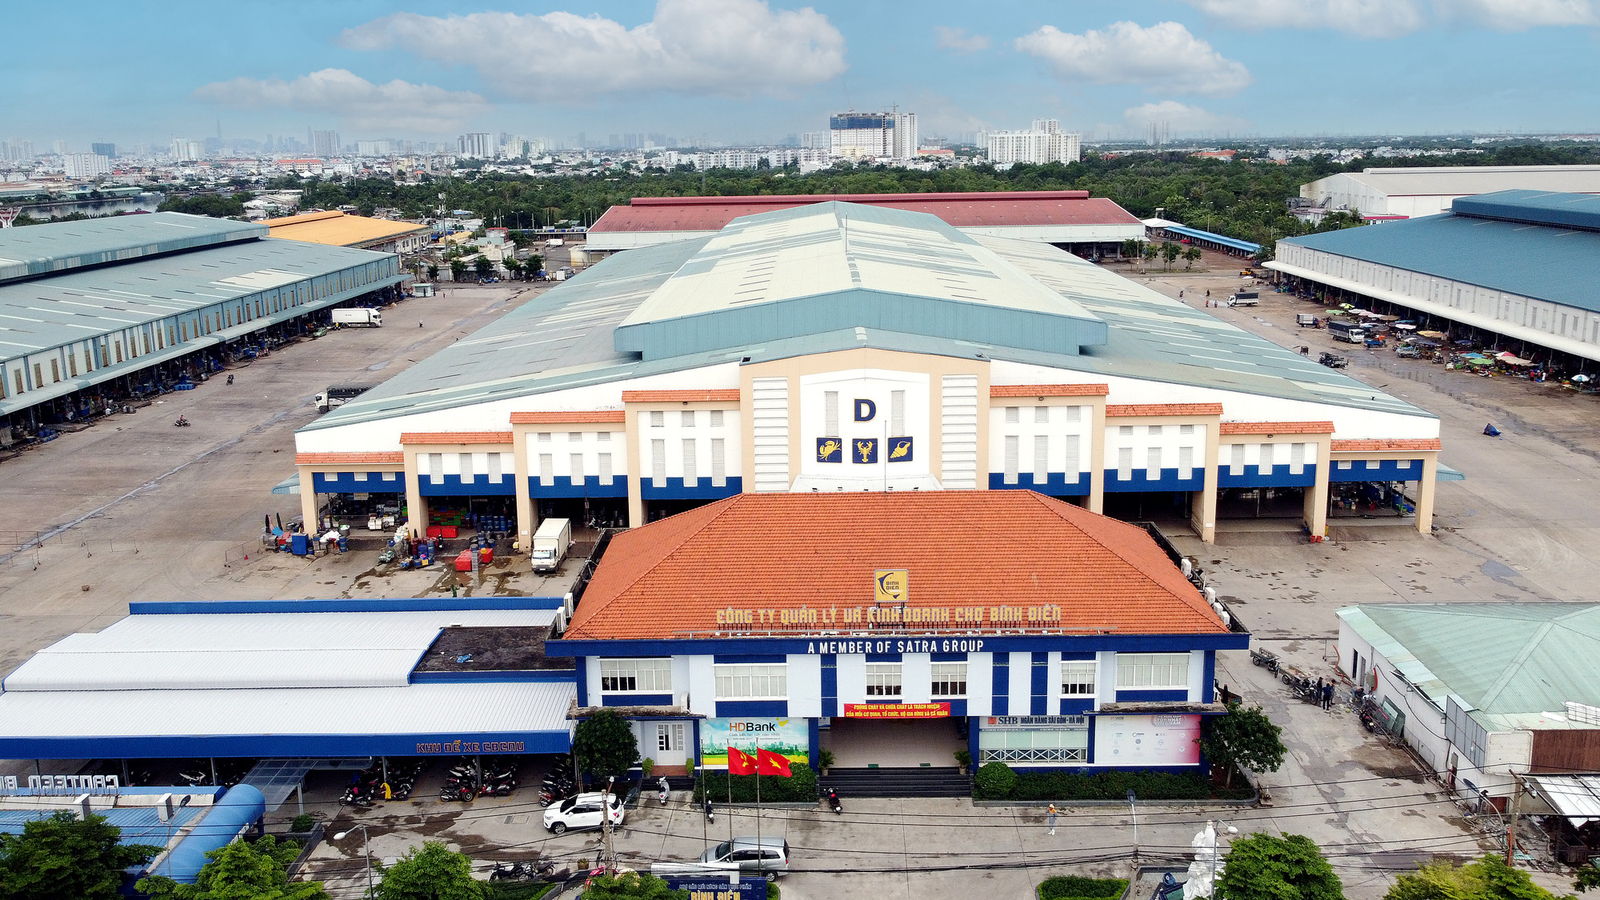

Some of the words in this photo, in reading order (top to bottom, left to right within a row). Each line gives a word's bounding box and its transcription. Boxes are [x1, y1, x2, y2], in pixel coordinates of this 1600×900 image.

[854, 398, 876, 422] D
[716, 605, 753, 624] CÔNG
[757, 608, 775, 624] TY
[781, 603, 817, 624] QUẢN
[822, 603, 837, 623] LÝ
[867, 606, 899, 623] KINH
[903, 607, 950, 622] DOANH
[990, 604, 1022, 622] BÌNH
[1028, 603, 1061, 622] ĐIỀN
[807, 642, 815, 654] A
[819, 641, 872, 654] MEMBER
[876, 641, 891, 653] OF
[897, 640, 937, 653] SATRA
[942, 639, 984, 652] GROUP
[729, 722, 776, 732] HDBank
[998, 716, 1018, 725] SHB
[1020, 716, 1033, 724] NGÂN
[1034, 716, 1047, 724] HÀNG
[416, 742, 442, 753] KHU
[443, 739, 461, 753] ĐỂ
[463, 742, 480, 752] XE
